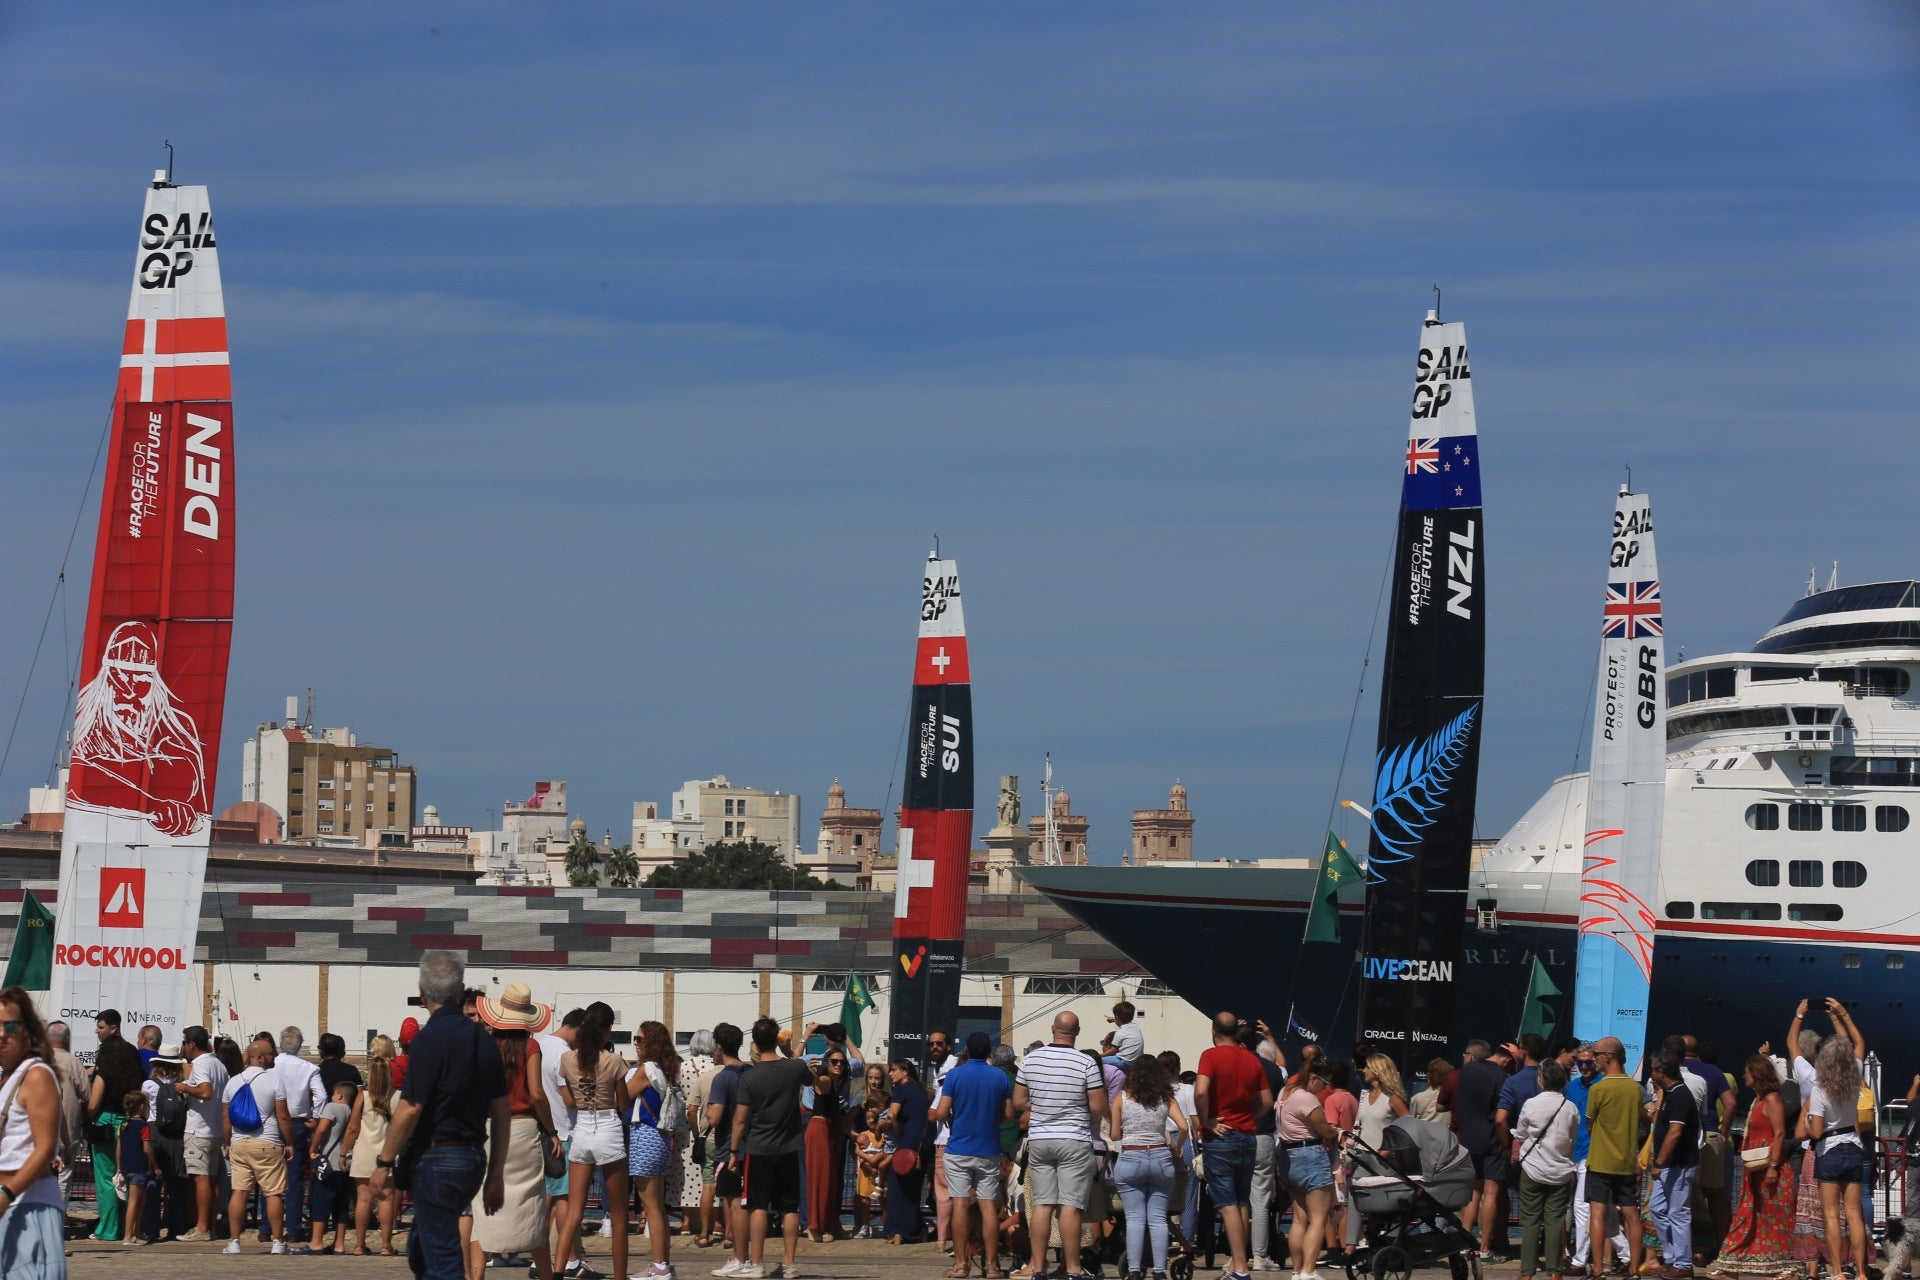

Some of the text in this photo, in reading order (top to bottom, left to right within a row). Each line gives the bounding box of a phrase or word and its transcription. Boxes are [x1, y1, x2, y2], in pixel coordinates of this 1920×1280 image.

[141, 213, 217, 250] SAIL
[139, 252, 194, 289] GP
[1415, 345, 1472, 383] SAIL
[1411, 384, 1452, 420] GP
[143, 411, 162, 518] THEFUTURE
[183, 412, 222, 541] DEN
[129, 441, 147, 538] #RACEFOR
[1612, 508, 1653, 538] SAIL
[1420, 515, 1434, 607] THEFUTURE
[1446, 519, 1475, 620] NZL
[1610, 541, 1640, 568] GP
[922, 576, 961, 599] SAIL
[1409, 542, 1422, 625] #RACEFOR
[921, 599, 947, 621] GP
[1618, 646, 1628, 698] FUTURE
[1637, 645, 1657, 729] GBR
[1604, 655, 1618, 741] PROTECT
[942, 714, 960, 773] SUI
[55, 944, 187, 970] ROCKWOOL
[1463, 949, 1566, 966] REAL
[60, 1008, 101, 1020] ORAC
[140, 1014, 176, 1025] NEAR.org
[1616, 1009, 1644, 1017] PROTECT
[1364, 1030, 1405, 1040] ORACLE
[74, 1050, 98, 1058] CAERU
